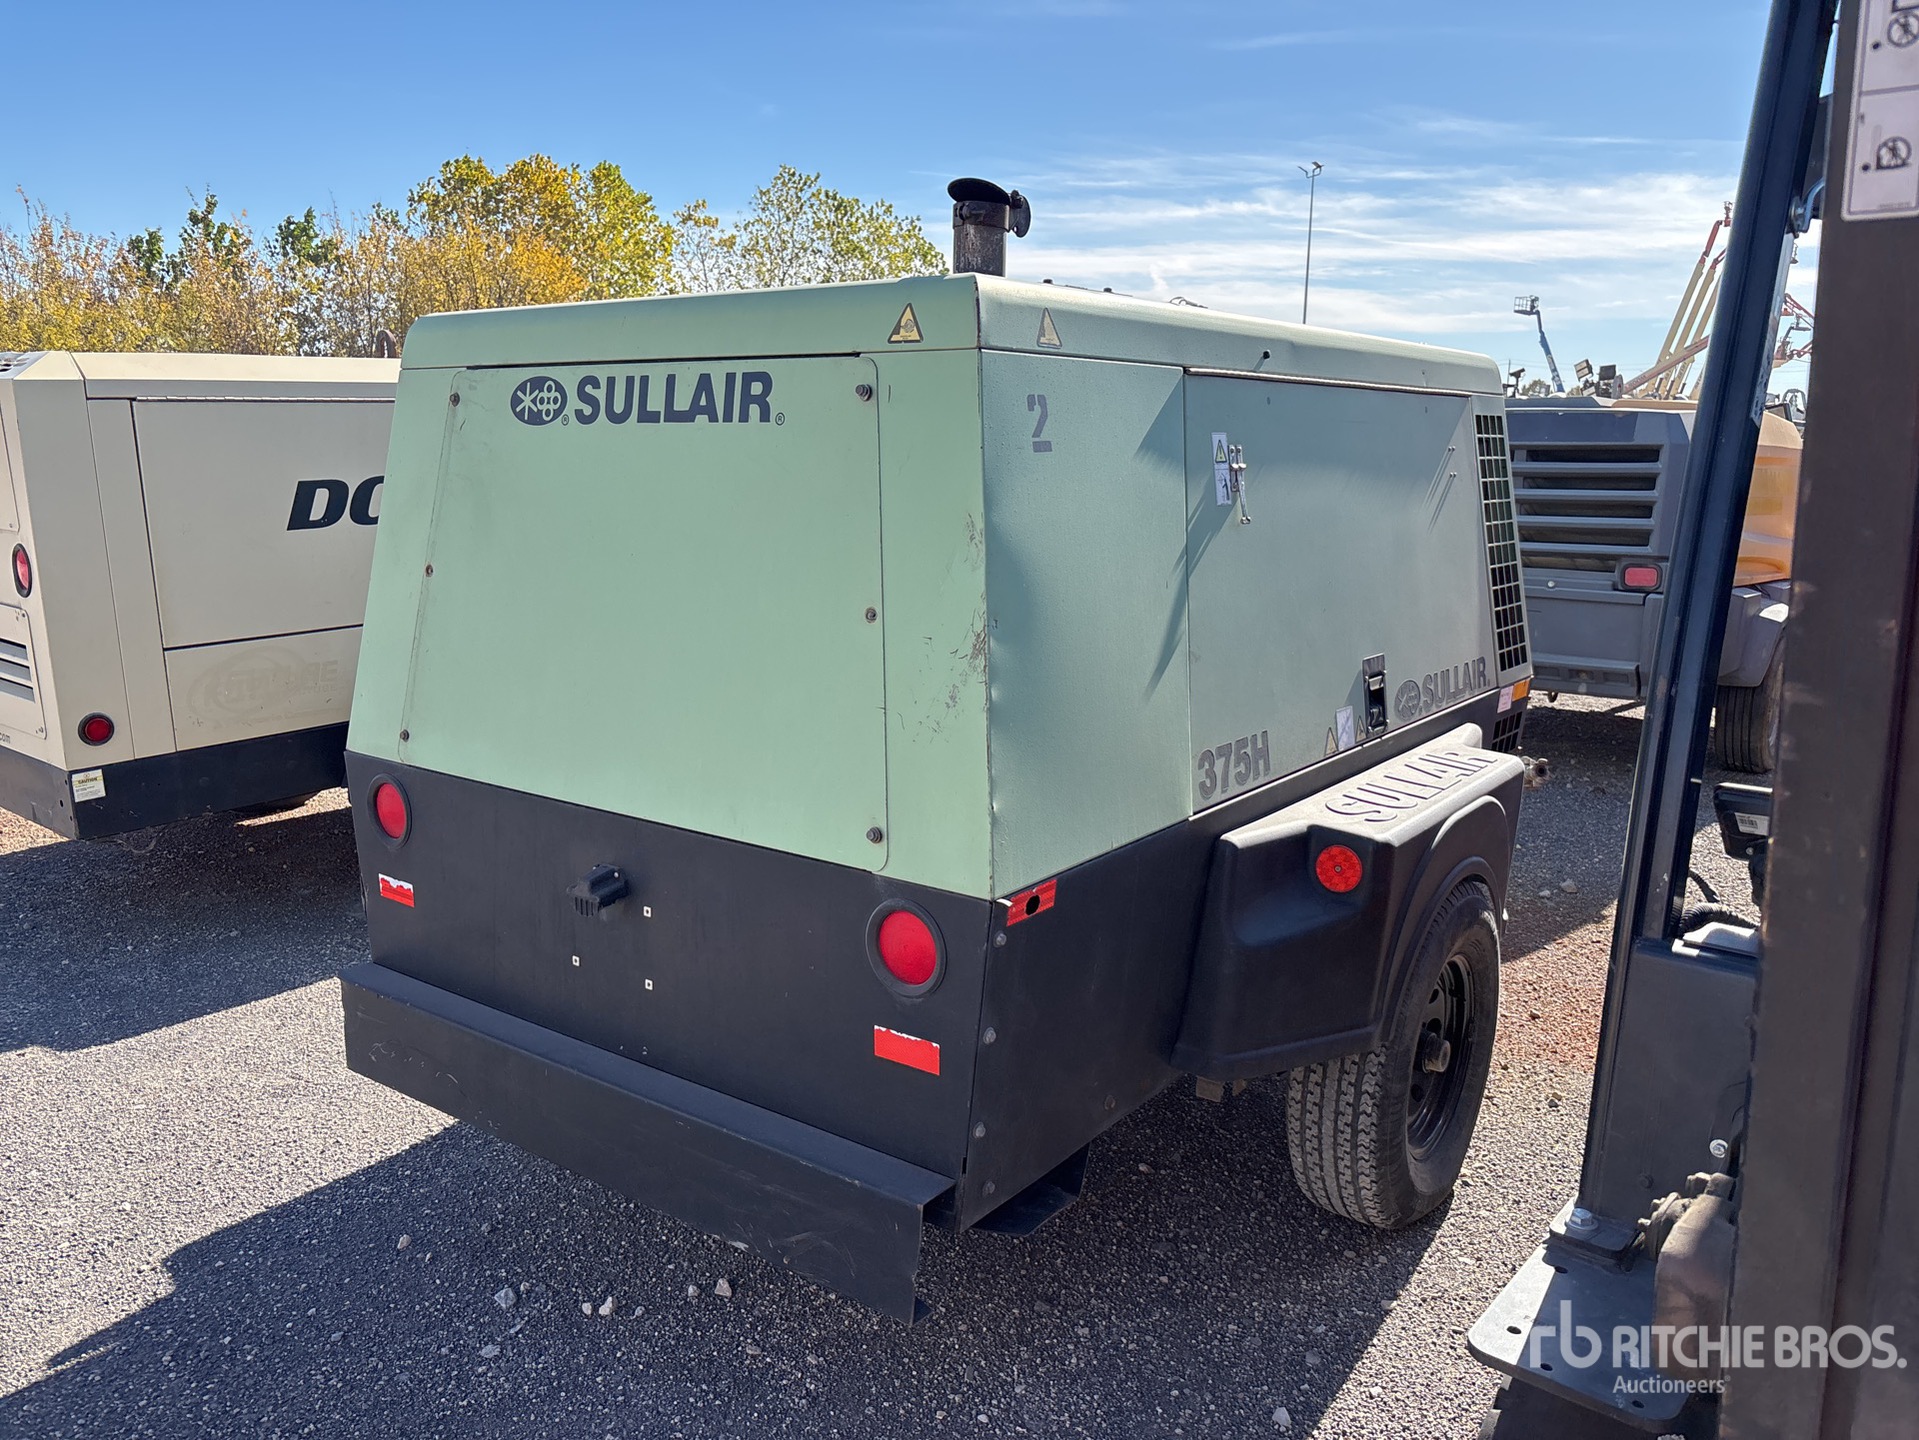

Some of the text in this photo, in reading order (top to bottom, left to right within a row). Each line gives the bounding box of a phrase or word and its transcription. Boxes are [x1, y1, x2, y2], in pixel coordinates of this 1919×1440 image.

[574, 371, 773, 425] SULLAIR
[1027, 394, 1053, 453] 2
[1421, 656, 1487, 712] SULLAIR
[1197, 729, 1271, 800] 375H
[1325, 752, 1498, 822] SULLAIR
